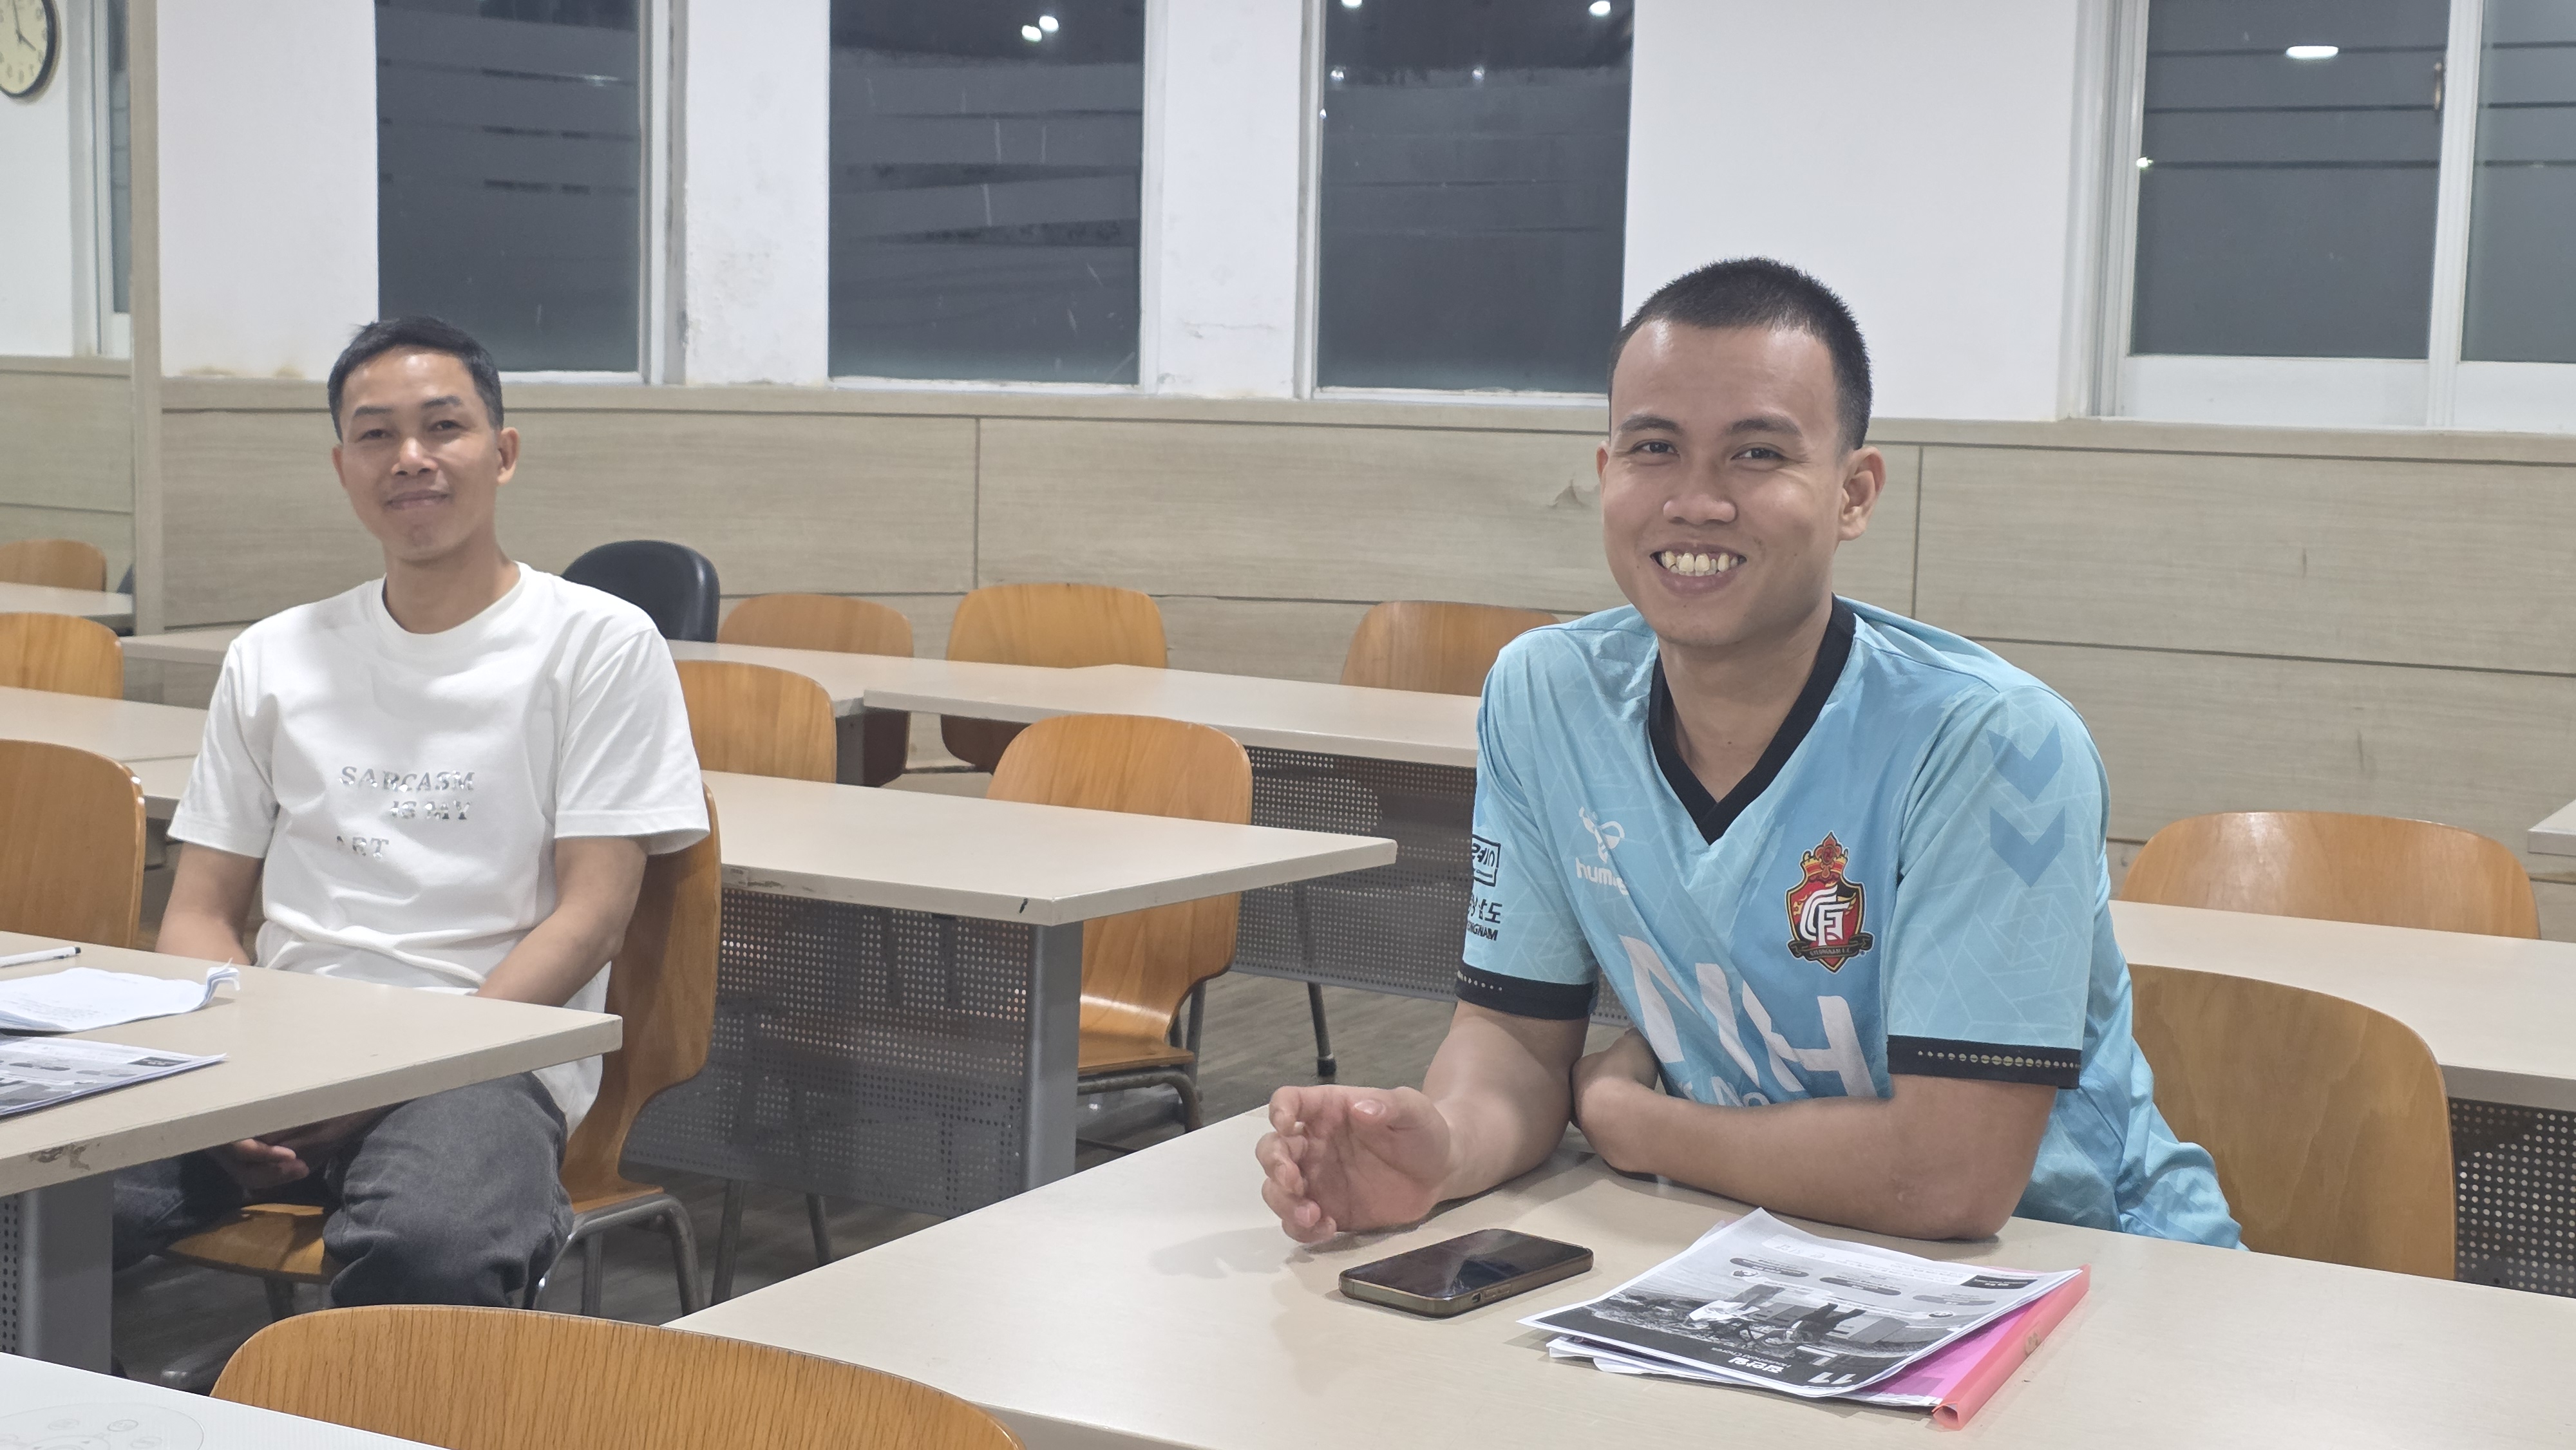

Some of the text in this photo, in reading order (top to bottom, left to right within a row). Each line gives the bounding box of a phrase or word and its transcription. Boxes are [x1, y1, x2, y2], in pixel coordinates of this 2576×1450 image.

[339, 766, 475, 793] SARCASM
[1618, 934, 1878, 1099] NH
[1728, 1357, 1785, 1374] 집안일
[1807, 1371, 1857, 1385] 11
